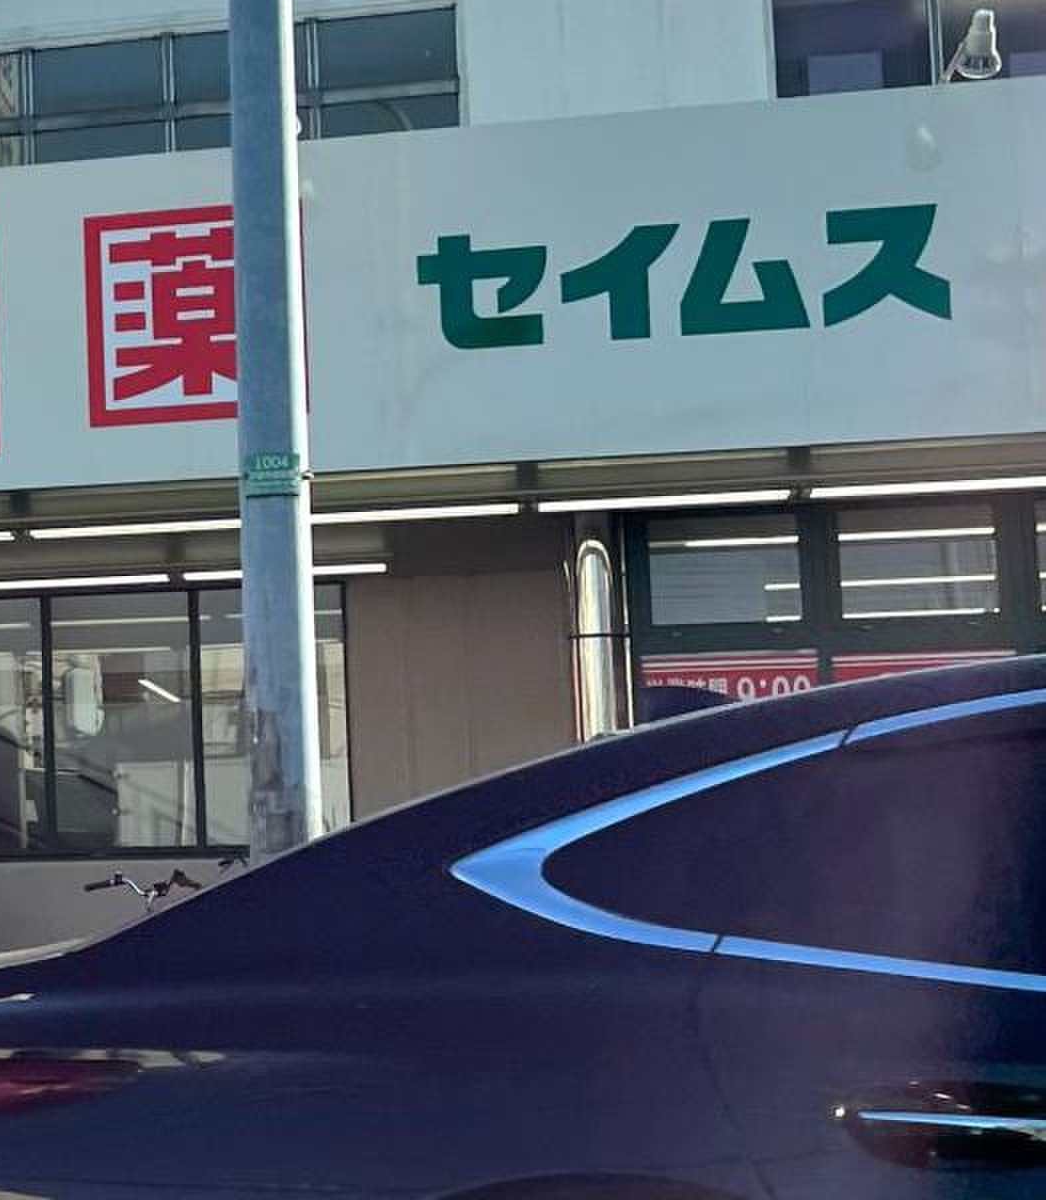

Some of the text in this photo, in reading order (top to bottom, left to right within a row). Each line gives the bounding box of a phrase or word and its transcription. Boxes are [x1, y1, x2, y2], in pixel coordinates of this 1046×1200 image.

[108, 224, 238, 401] 薬
[417, 203, 952, 349] セイムス
